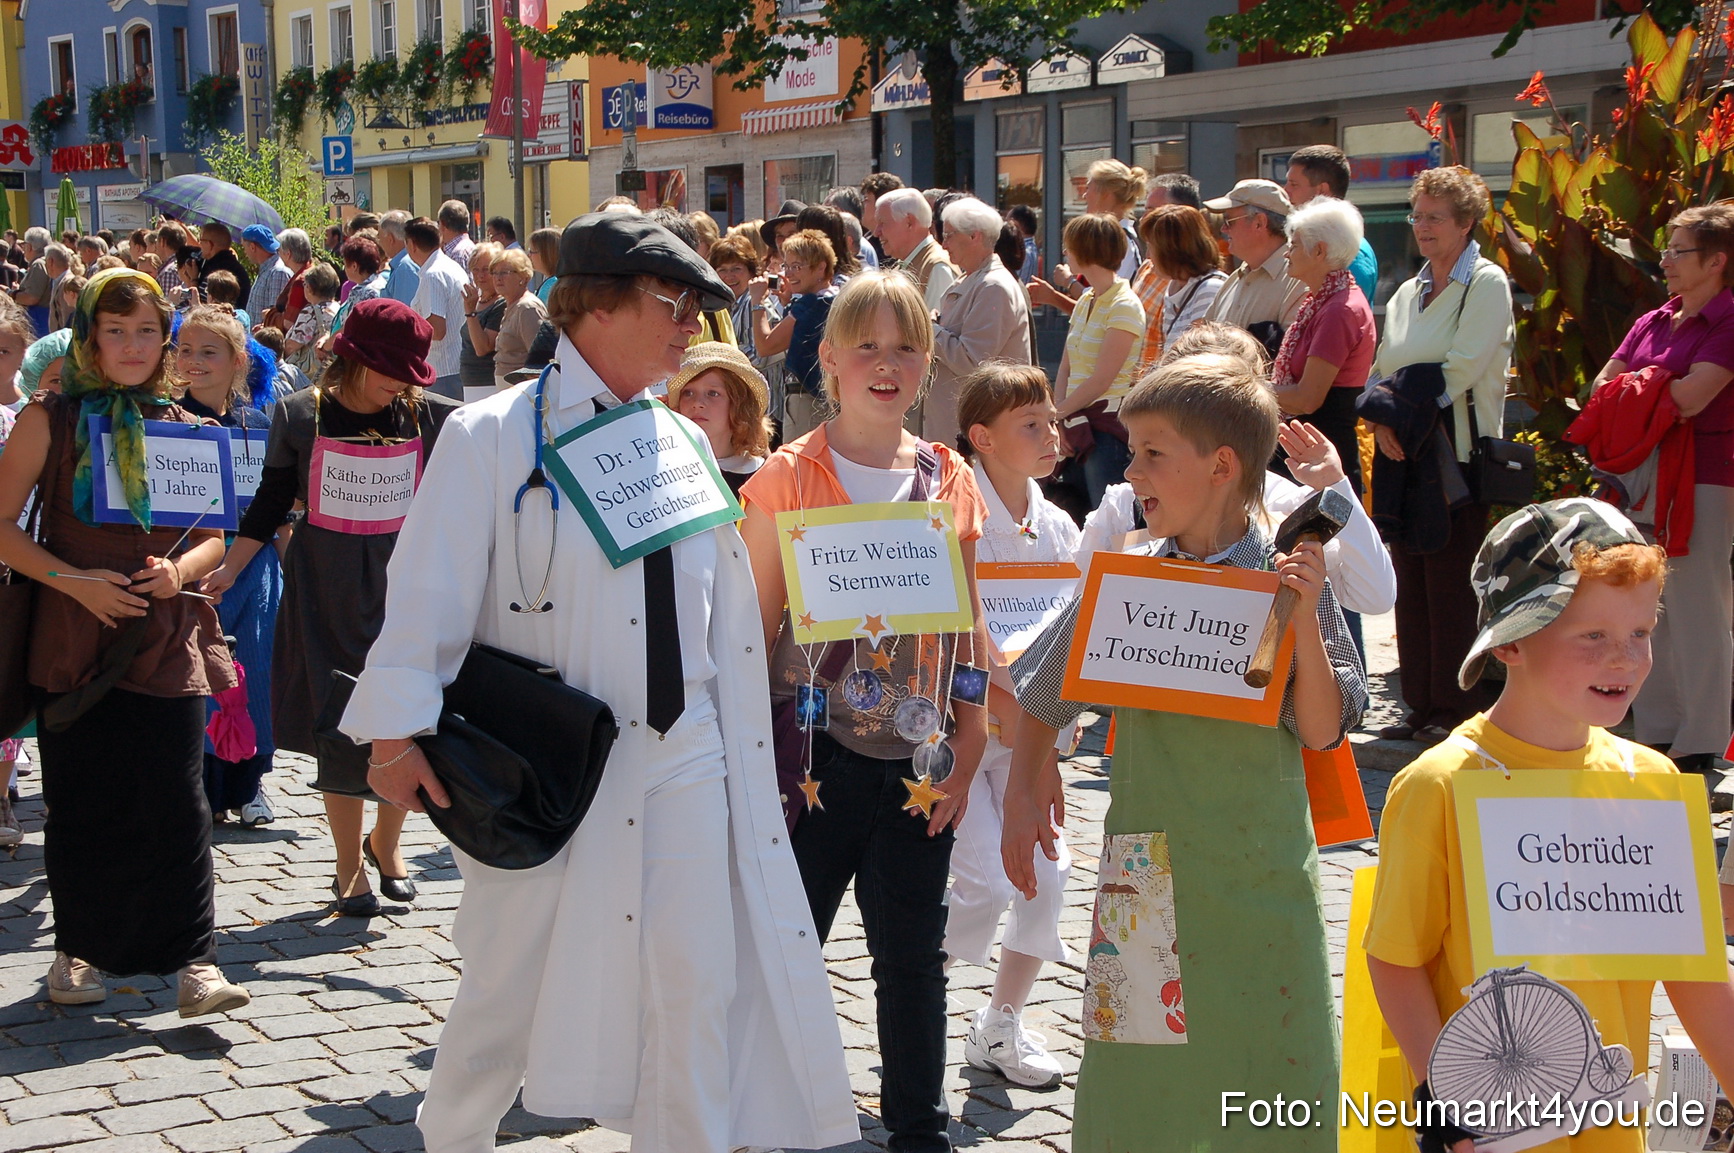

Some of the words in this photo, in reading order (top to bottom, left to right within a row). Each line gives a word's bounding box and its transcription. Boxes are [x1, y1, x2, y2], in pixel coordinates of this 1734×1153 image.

[786, 69, 816, 88] Mode
[571, 84, 582, 154] KINO
[658, 113, 709, 125] Reisebüro
[329, 141, 346, 172] P
[155, 454, 219, 475] Stephan
[234, 454, 264, 468] phan
[593, 452, 632, 477] Dr.
[631, 433, 678, 462] Franz
[234, 470, 255, 484] hre
[325, 466, 367, 486] Käthe
[370, 467, 412, 486] Dorsch
[596, 460, 703, 511] Schweninger
[164, 480, 207, 496] Jahre
[322, 484, 412, 506] Schauspielerin
[626, 488, 710, 530] Gerichtsarzt
[811, 545, 858, 566] Fritz
[862, 540, 938, 562] Weithas
[828, 571, 931, 593] Sternwarte
[981, 596, 1048, 613] Willibald
[1123, 600, 1177, 631] Veit
[1184, 608, 1250, 647] Jung
[1516, 832, 1654, 867] Gebrüder
[1495, 880, 1685, 915] Goldschmidt
